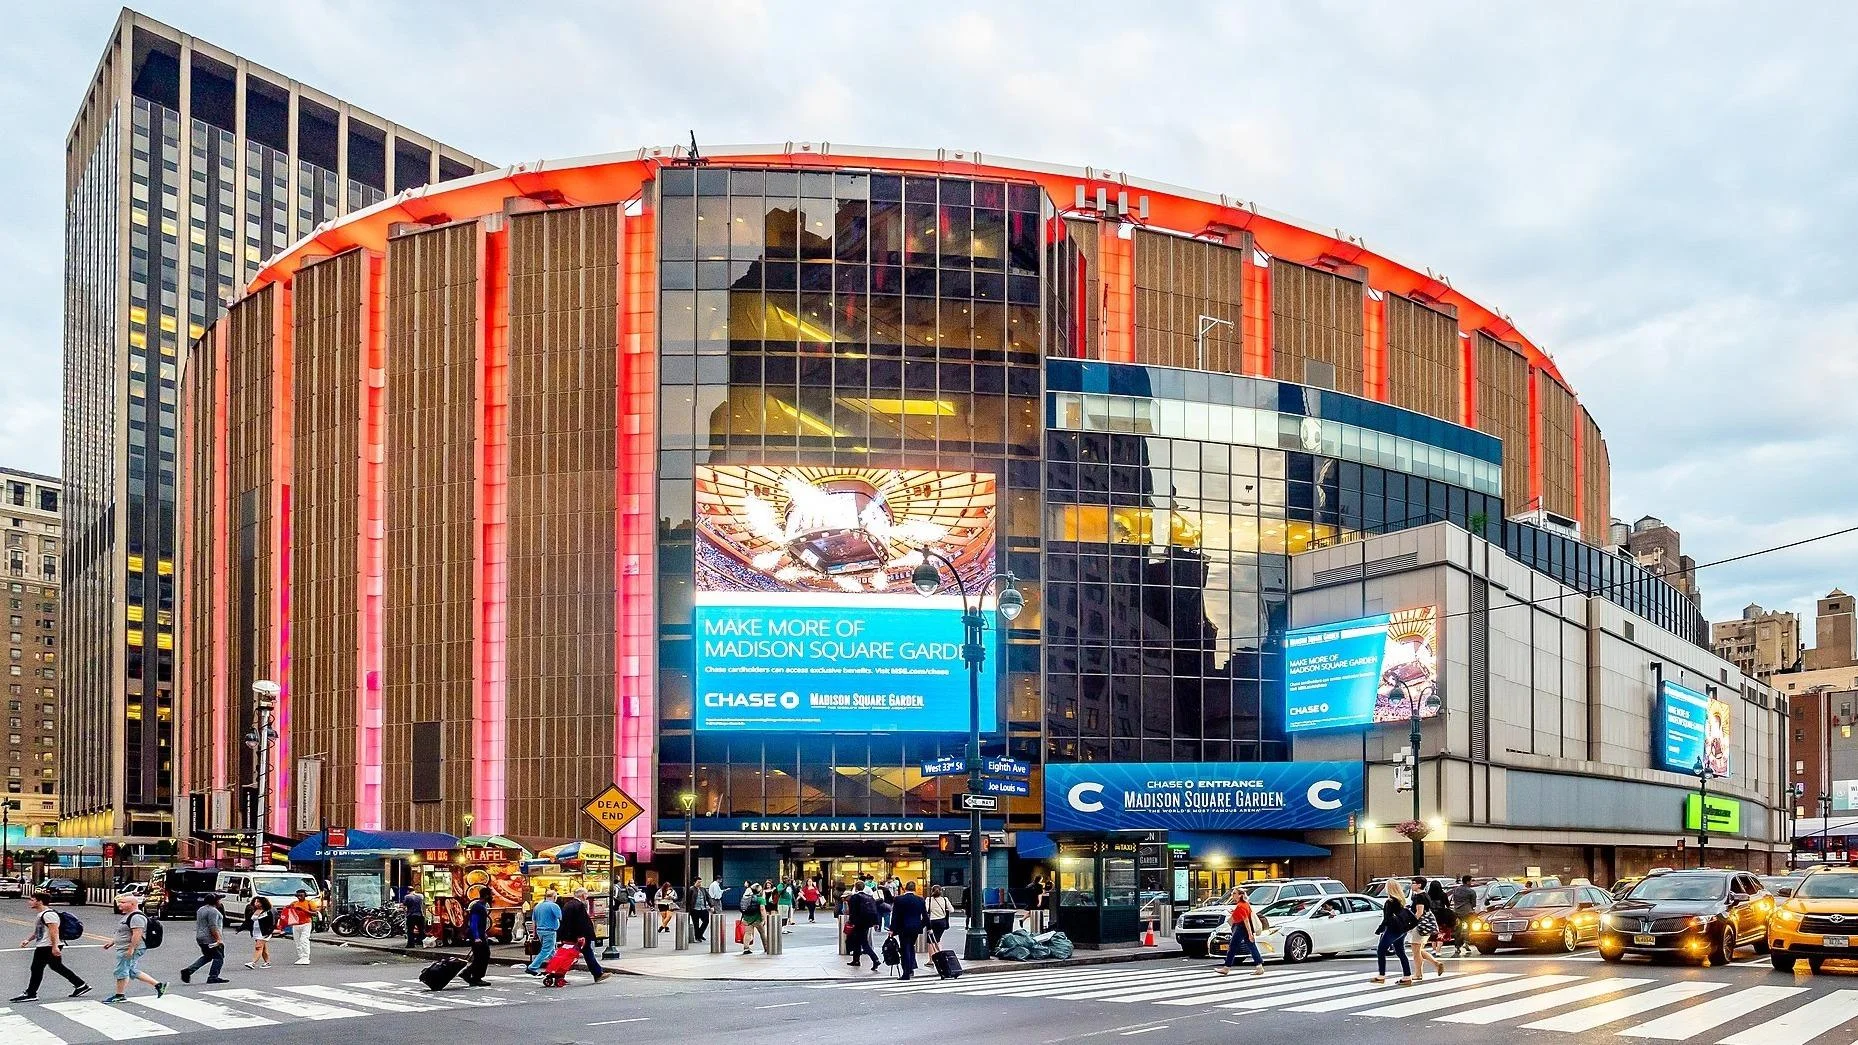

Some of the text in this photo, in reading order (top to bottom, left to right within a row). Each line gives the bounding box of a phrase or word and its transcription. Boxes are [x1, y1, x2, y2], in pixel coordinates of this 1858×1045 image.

[704, 618, 866, 638] MAKE MORE OF
[704, 640, 965, 662] MADISON SQUARE GARDE
[1290, 653, 1339, 667] MAKE MORE OF
[1290, 655, 1377, 675] MADISON SQUARE GARDEN
[705, 692, 777, 707] CHASE
[810, 692, 851, 706] MADISON
[853, 693, 886, 707] SQUARE
[1290, 706, 1319, 715] CHASE
[925, 762, 963, 773] West 33rd St
[989, 762, 1026, 773] Eighth Ave
[989, 782, 999, 791] Joe
[1000, 783, 1015, 792] Louis
[1068, 782, 1105, 812] C
[1124, 791, 1180, 808] MADISON
[1185, 791, 1231, 808] SQUARE
[1307, 780, 1343, 810] C
[597, 801, 628, 809] DEAD
[602, 812, 624, 820] END
[741, 823, 924, 831] PENNSYLVANIA STATION
[426, 850, 448, 861] HOT DOG
[1139, 856, 1158, 864] GARDEN
